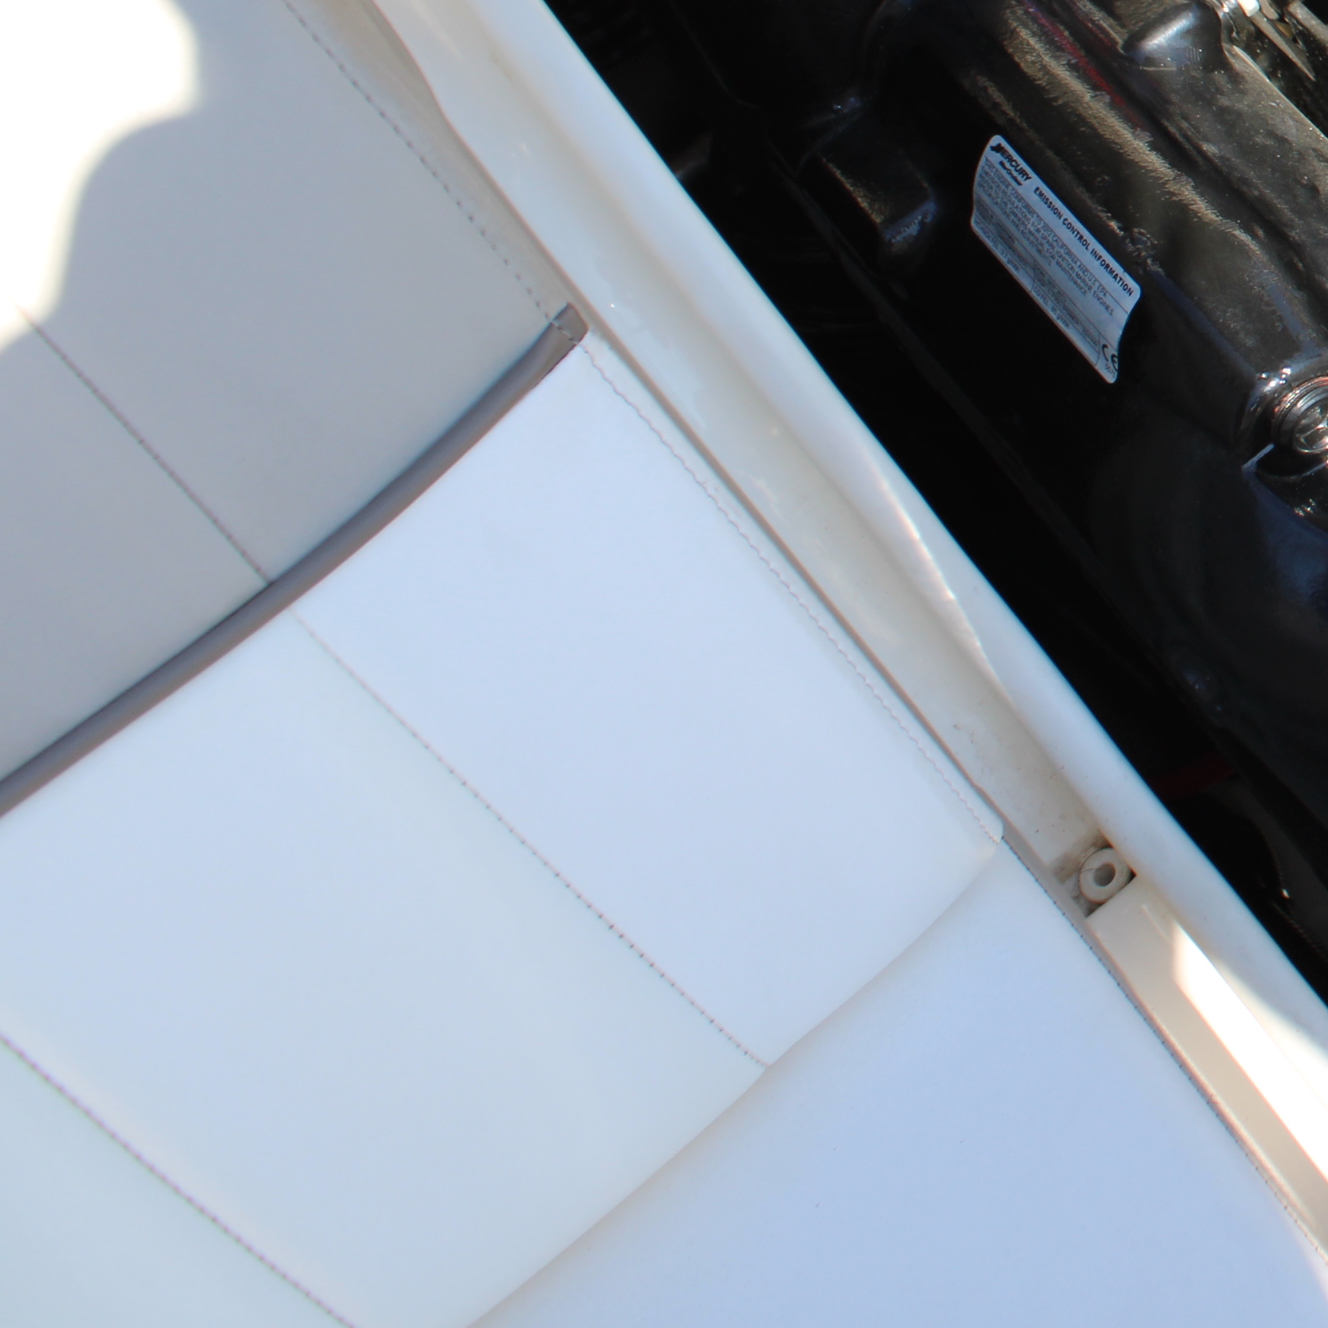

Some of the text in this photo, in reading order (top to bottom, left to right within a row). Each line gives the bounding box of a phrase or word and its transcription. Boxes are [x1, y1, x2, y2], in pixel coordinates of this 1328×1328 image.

[989, 139, 1032, 184] MERCURY
[1032, 186, 1064, 219] EMISSION
[1060, 217, 1092, 250] CONTROL
[1088, 247, 1135, 297] INFORMATION
